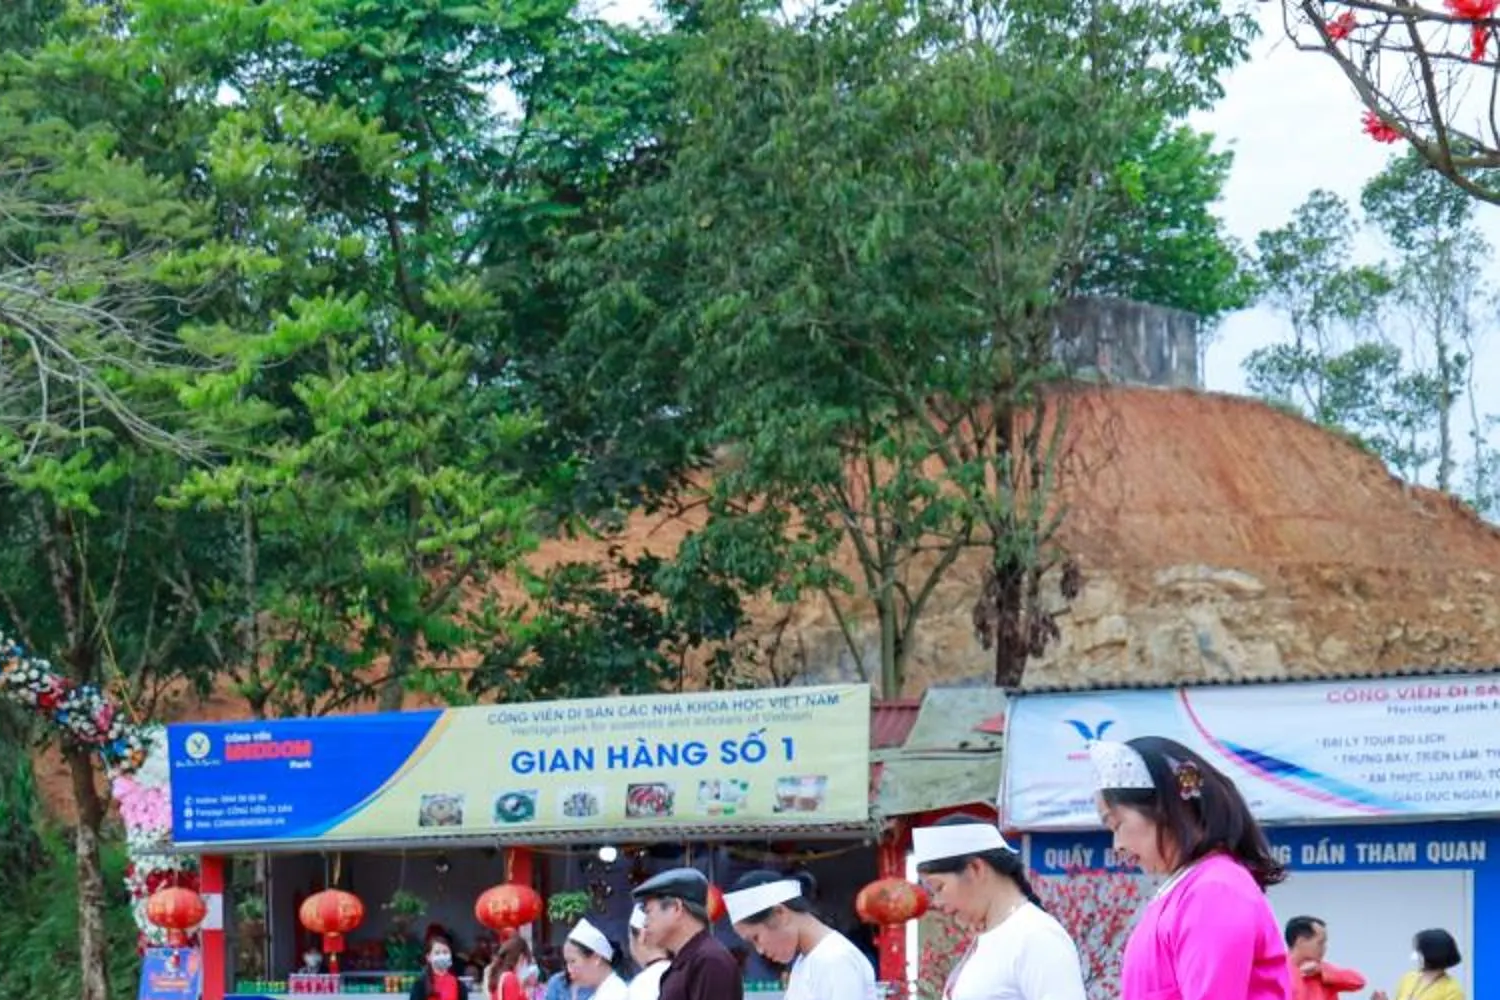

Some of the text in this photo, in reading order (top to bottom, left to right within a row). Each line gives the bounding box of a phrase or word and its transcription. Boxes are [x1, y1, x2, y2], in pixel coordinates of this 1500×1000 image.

[806, 693, 840, 705] NAM
[511, 727, 794, 774] GIAN HÀNG SỐ 1
[1356, 842, 1417, 865] THAM
[1426, 840, 1487, 865] QUAN
